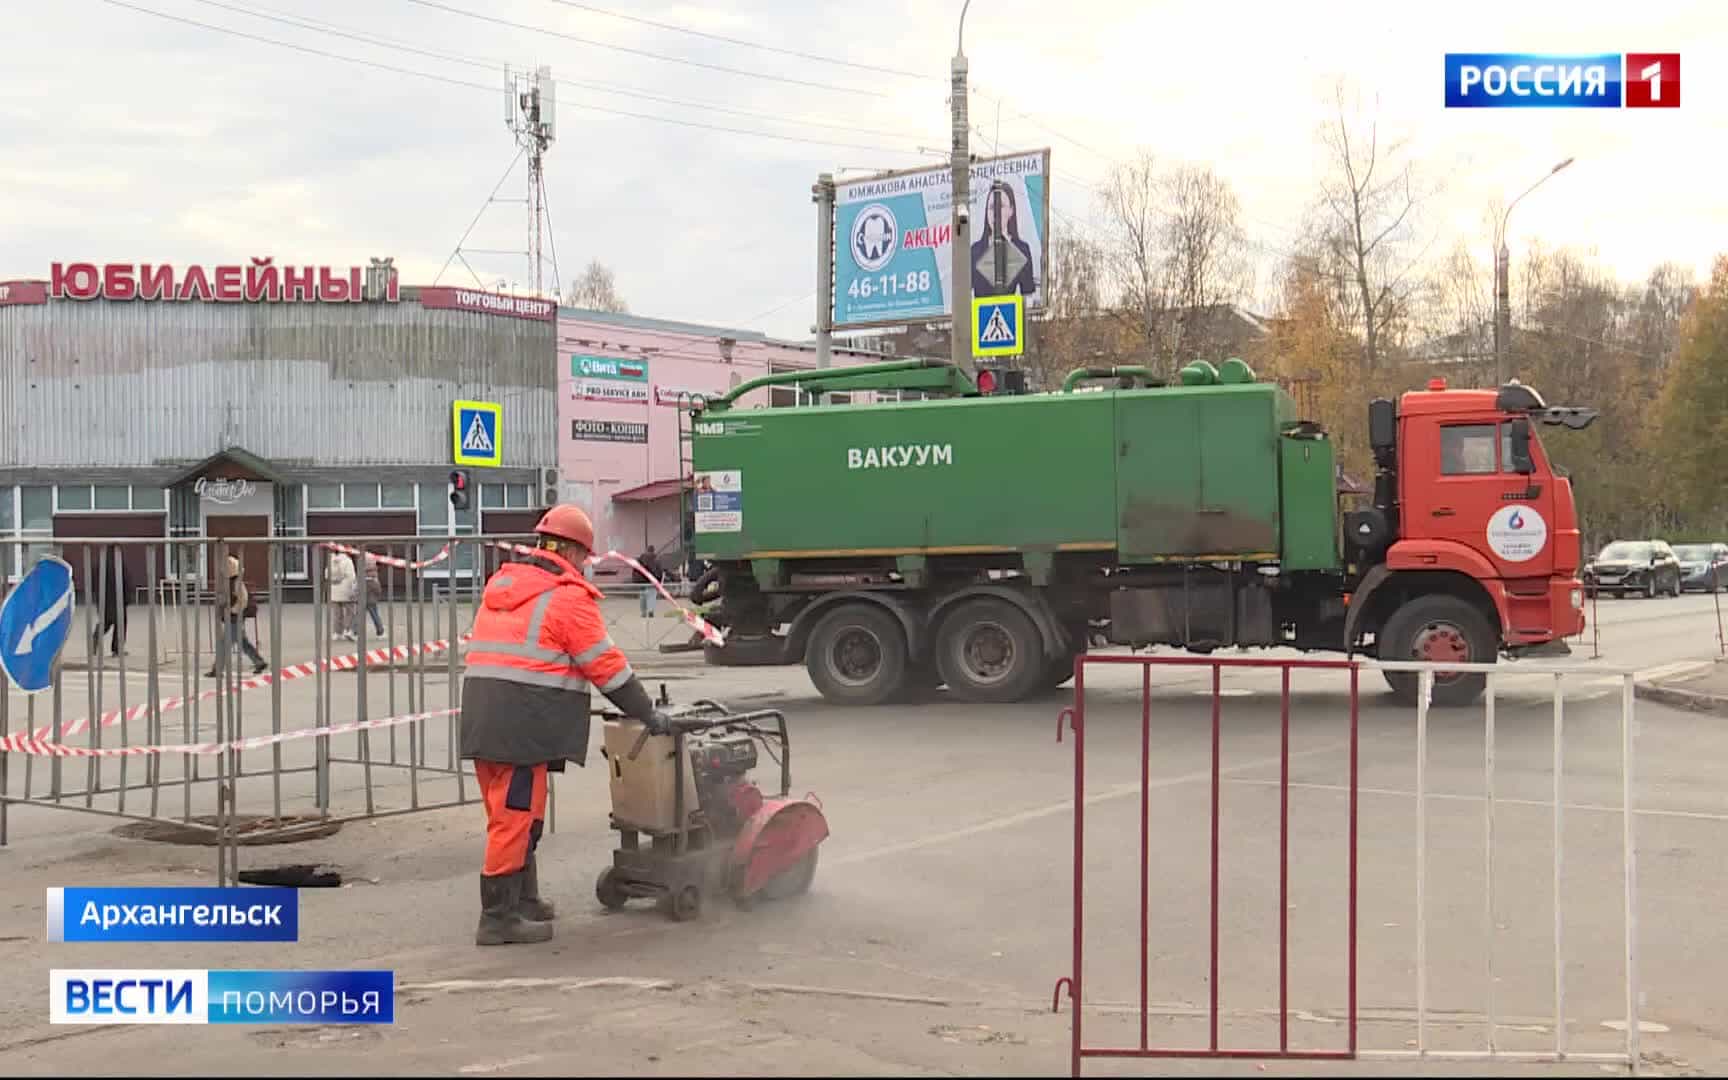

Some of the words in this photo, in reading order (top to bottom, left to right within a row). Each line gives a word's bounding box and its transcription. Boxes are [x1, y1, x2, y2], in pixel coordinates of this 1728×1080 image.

[909, 173, 953, 190] АНАСТАС
[904, 224, 953, 249] АКЦИ
[50, 256, 400, 302] ЮБИЛЕЙНЫЙ
[848, 271, 930, 298] 46-11-88
[455, 290, 513, 312] ТОРГОВЫЙ
[516, 299, 551, 316] ЦЕНТР
[848, 443, 952, 468] ВАКУУМ
